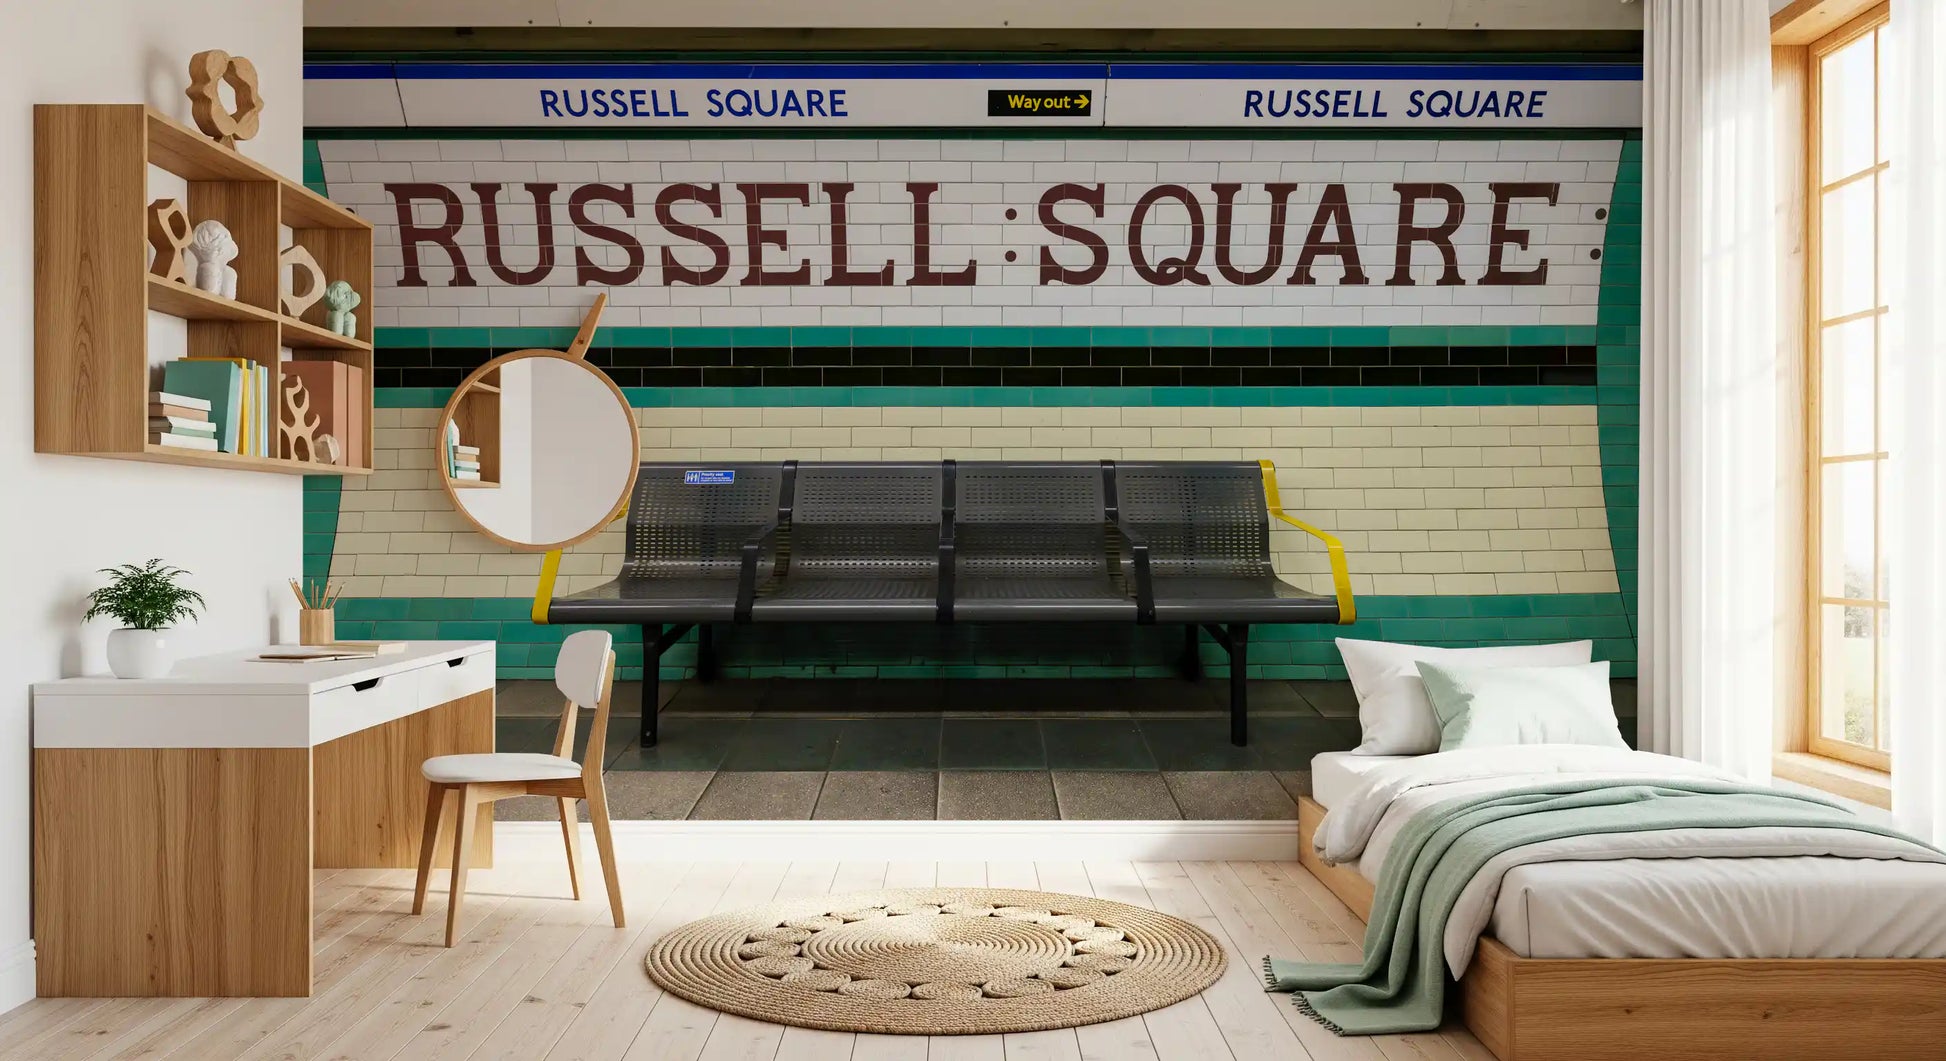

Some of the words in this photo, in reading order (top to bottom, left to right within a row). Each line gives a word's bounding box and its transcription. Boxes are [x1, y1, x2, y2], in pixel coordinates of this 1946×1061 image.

[540, 89, 689, 117] RUSSELL
[706, 89, 848, 118] SQUARE
[1007, 94, 1042, 112] Way
[1043, 95, 1071, 109] out
[1243, 89, 1388, 118] RUSSELL
[1405, 89, 1547, 119] SQUARE
[384, 182, 978, 288] RUSSELL
